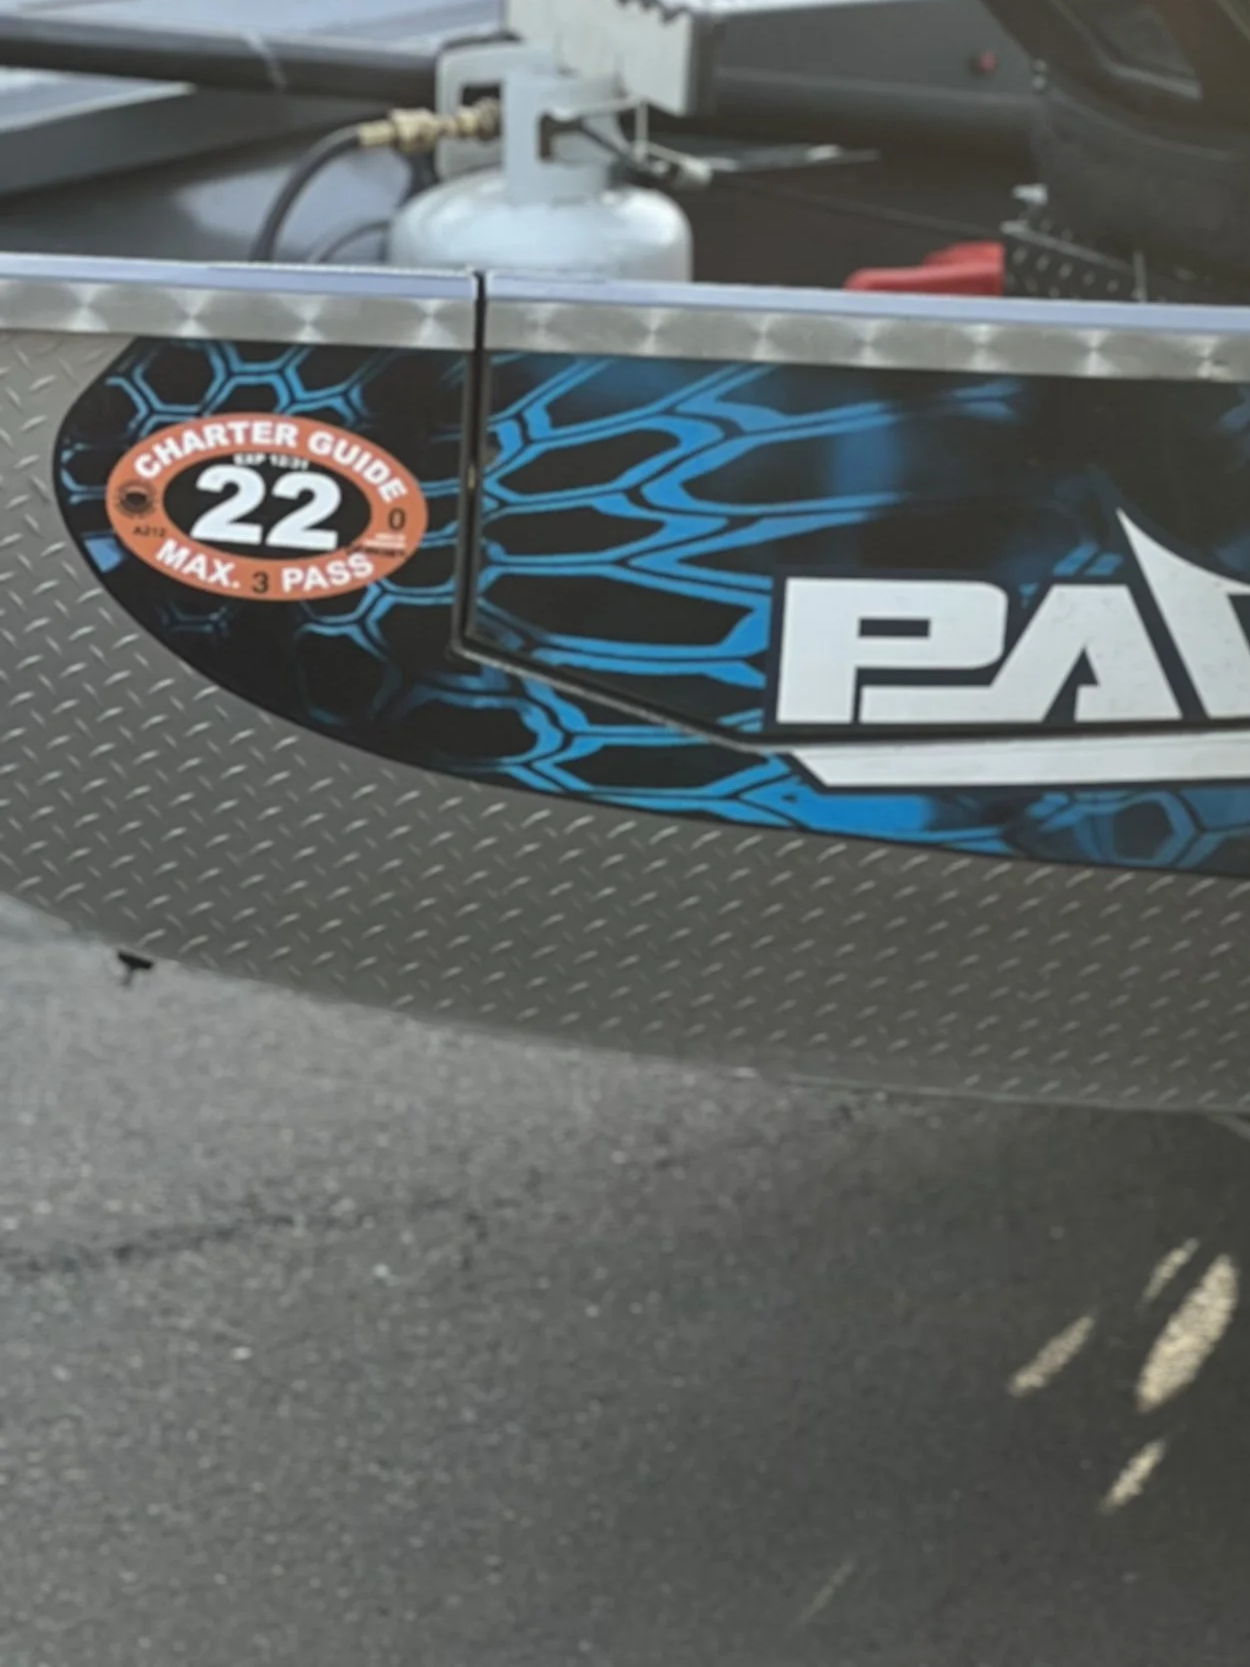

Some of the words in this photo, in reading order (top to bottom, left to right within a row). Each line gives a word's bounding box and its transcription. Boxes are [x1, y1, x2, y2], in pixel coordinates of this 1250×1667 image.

[134, 420, 298, 478] CHARTER
[307, 430, 408, 504] GUIDE
[190, 464, 341, 551] 22
[155, 539, 241, 590] MAX.
[252, 572, 270, 594] 3
[281, 552, 374, 593] PASS
